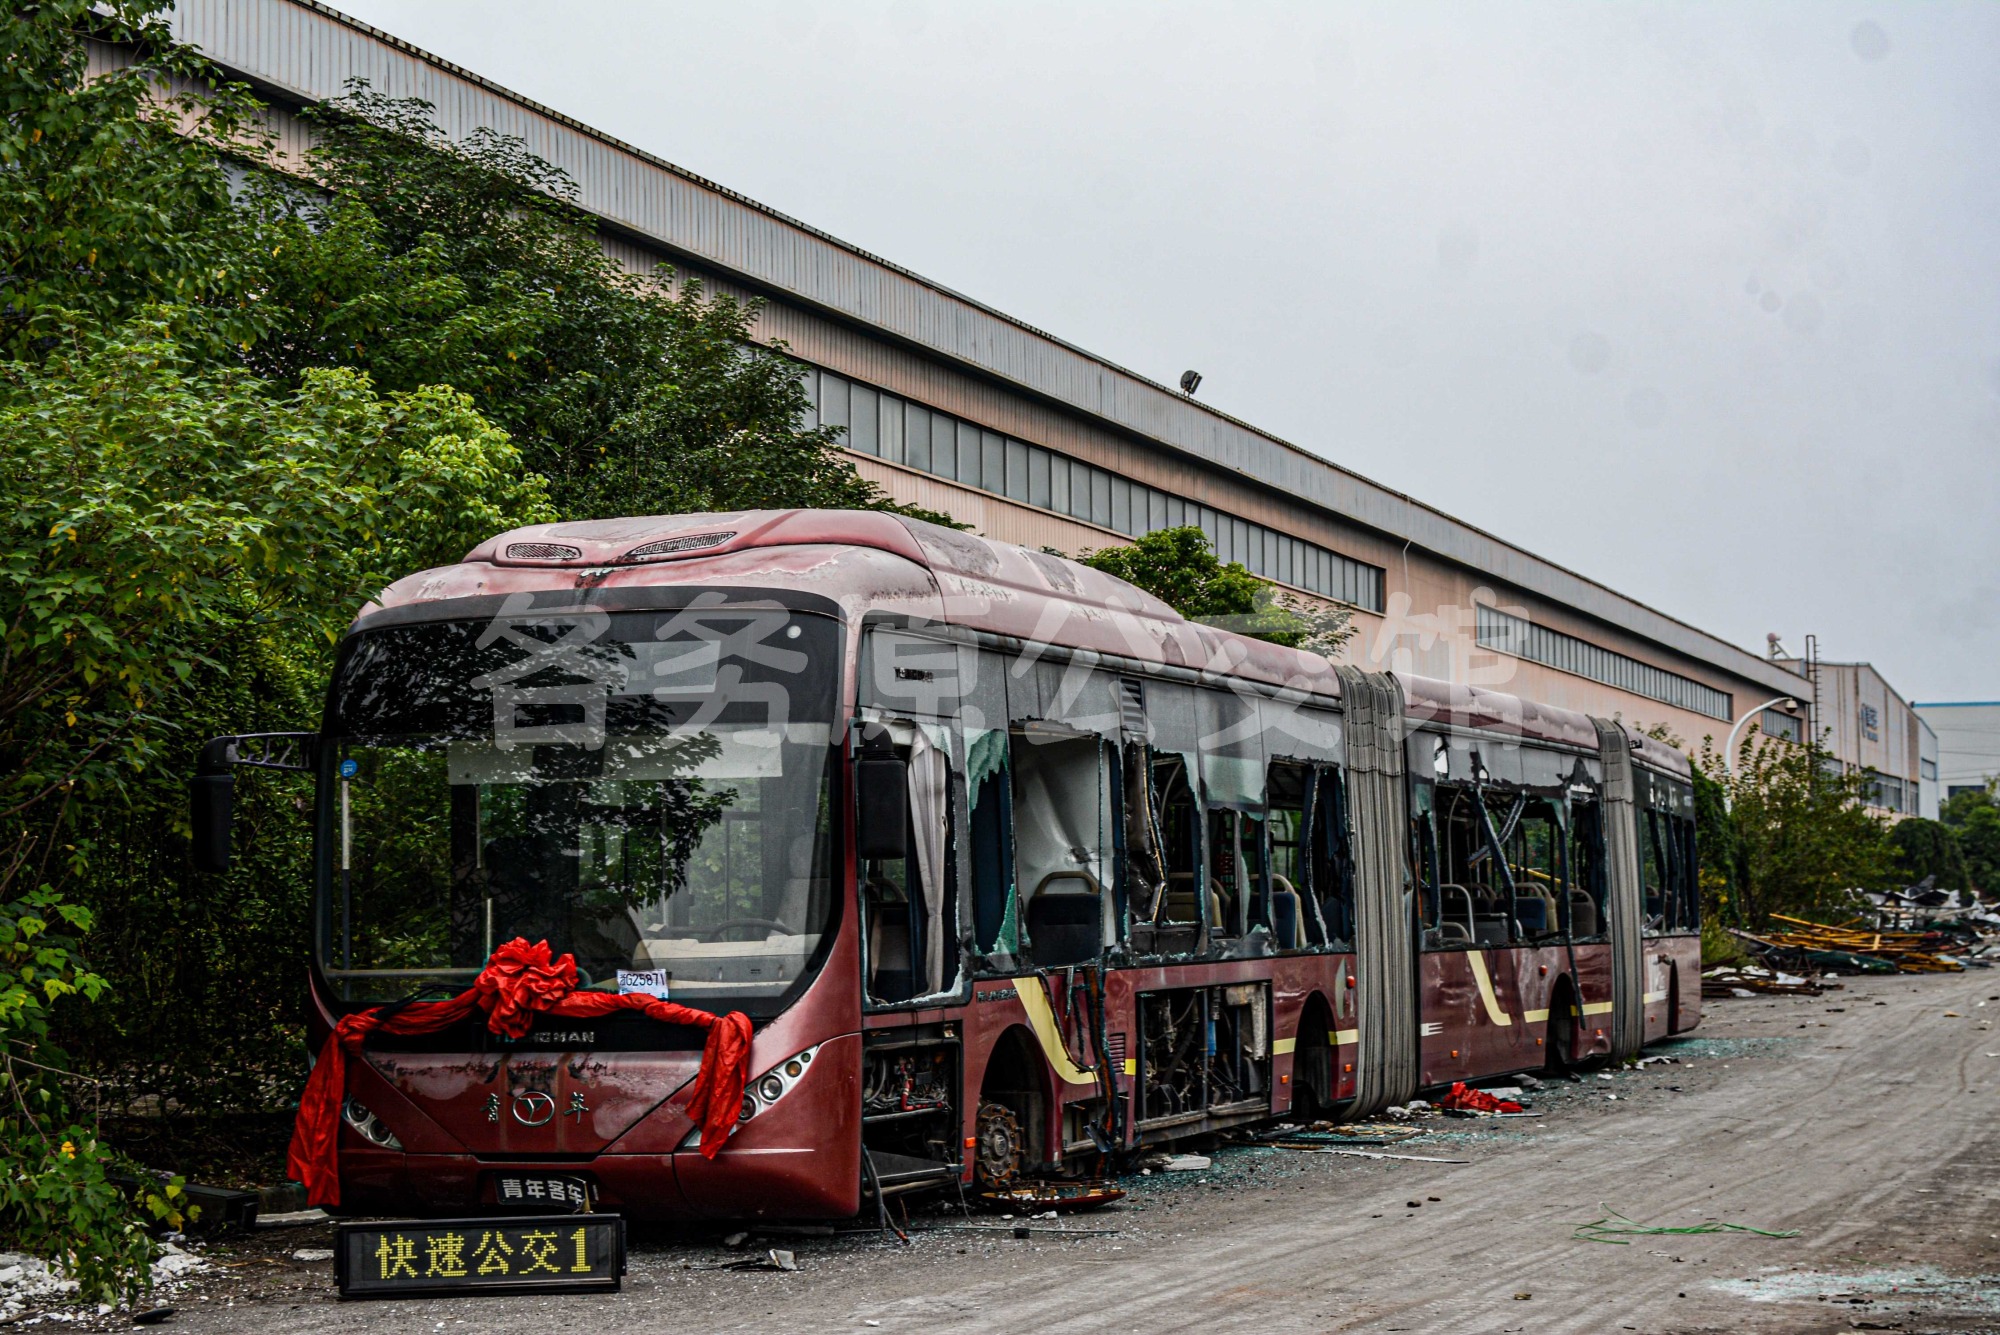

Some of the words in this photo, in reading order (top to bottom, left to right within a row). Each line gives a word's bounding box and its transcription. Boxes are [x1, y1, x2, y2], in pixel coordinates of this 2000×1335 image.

[501, 1178, 586, 1206] 青年客车
[375, 1227, 592, 1280] 快速公交1
